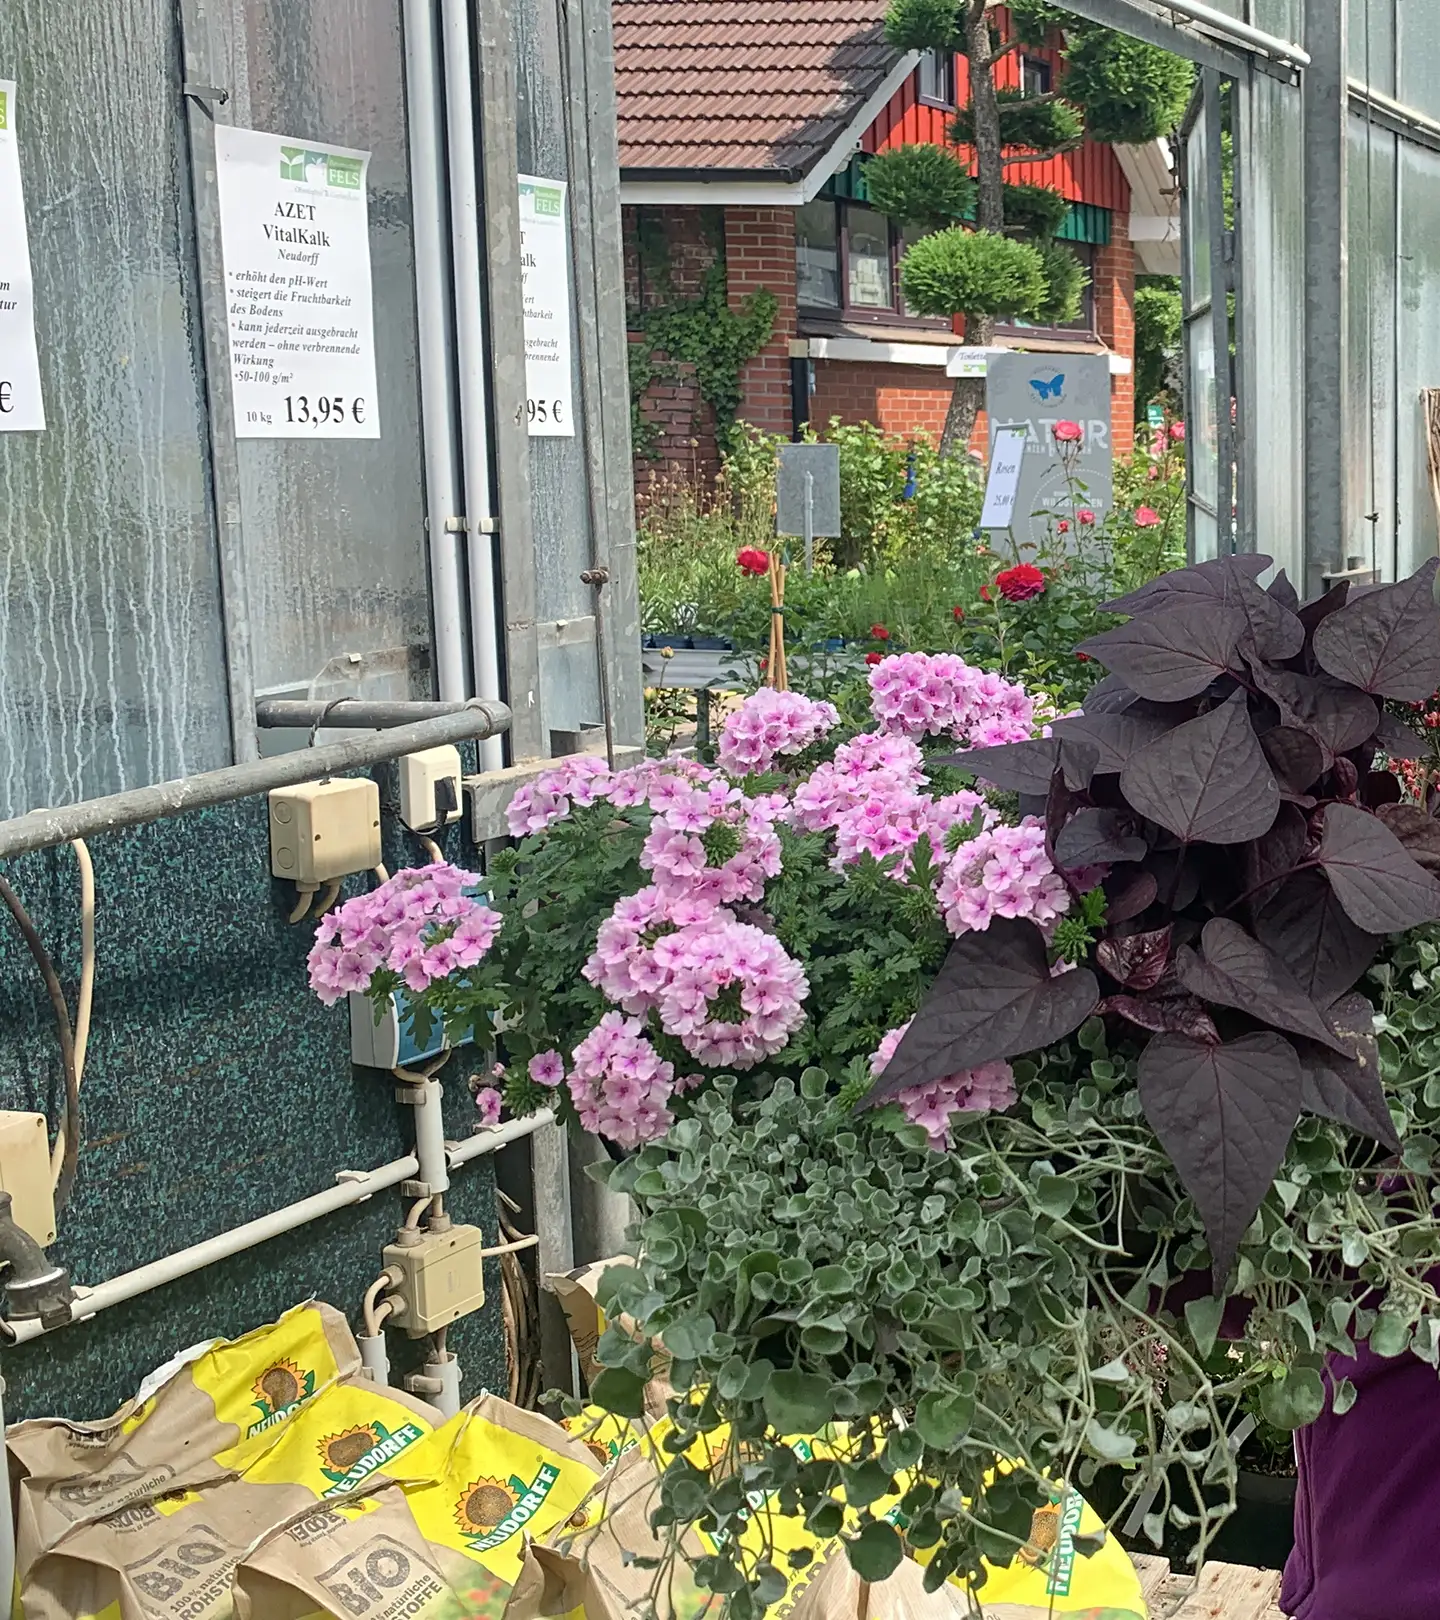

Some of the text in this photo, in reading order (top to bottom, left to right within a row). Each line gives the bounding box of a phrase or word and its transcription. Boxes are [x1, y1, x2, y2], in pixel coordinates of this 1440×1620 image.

[329, 168, 359, 186] FELS
[274, 200, 316, 221] AZET
[536, 198, 560, 214] FELS
[262, 223, 331, 247] VitalKalk
[278, 248, 320, 266] Neudorff
[236, 270, 328, 289] erhöht den pH-Wert
[236, 288, 352, 306] steigert die Fruchtbarkeit
[230, 304, 284, 318] des Bodens
[238, 320, 358, 340] kann jederzeit ausgebracht
[232, 338, 266, 350] werden
[277, 340, 300, 351] ohne
[302, 342, 360, 354] verbrennende
[234, 353, 274, 368] Wirkung
[246, 411, 272, 425] 10 kg
[284, 395, 366, 429] 13,95 €
[324, 1424, 417, 1499] NEUDORFF
[468, 1465, 556, 1551] NEUDORFF
[132, 1542, 226, 1602] BIO
[328, 1548, 410, 1616] BIO
[170, 1596, 192, 1614] 100
[190, 1587, 202, 1598] %
